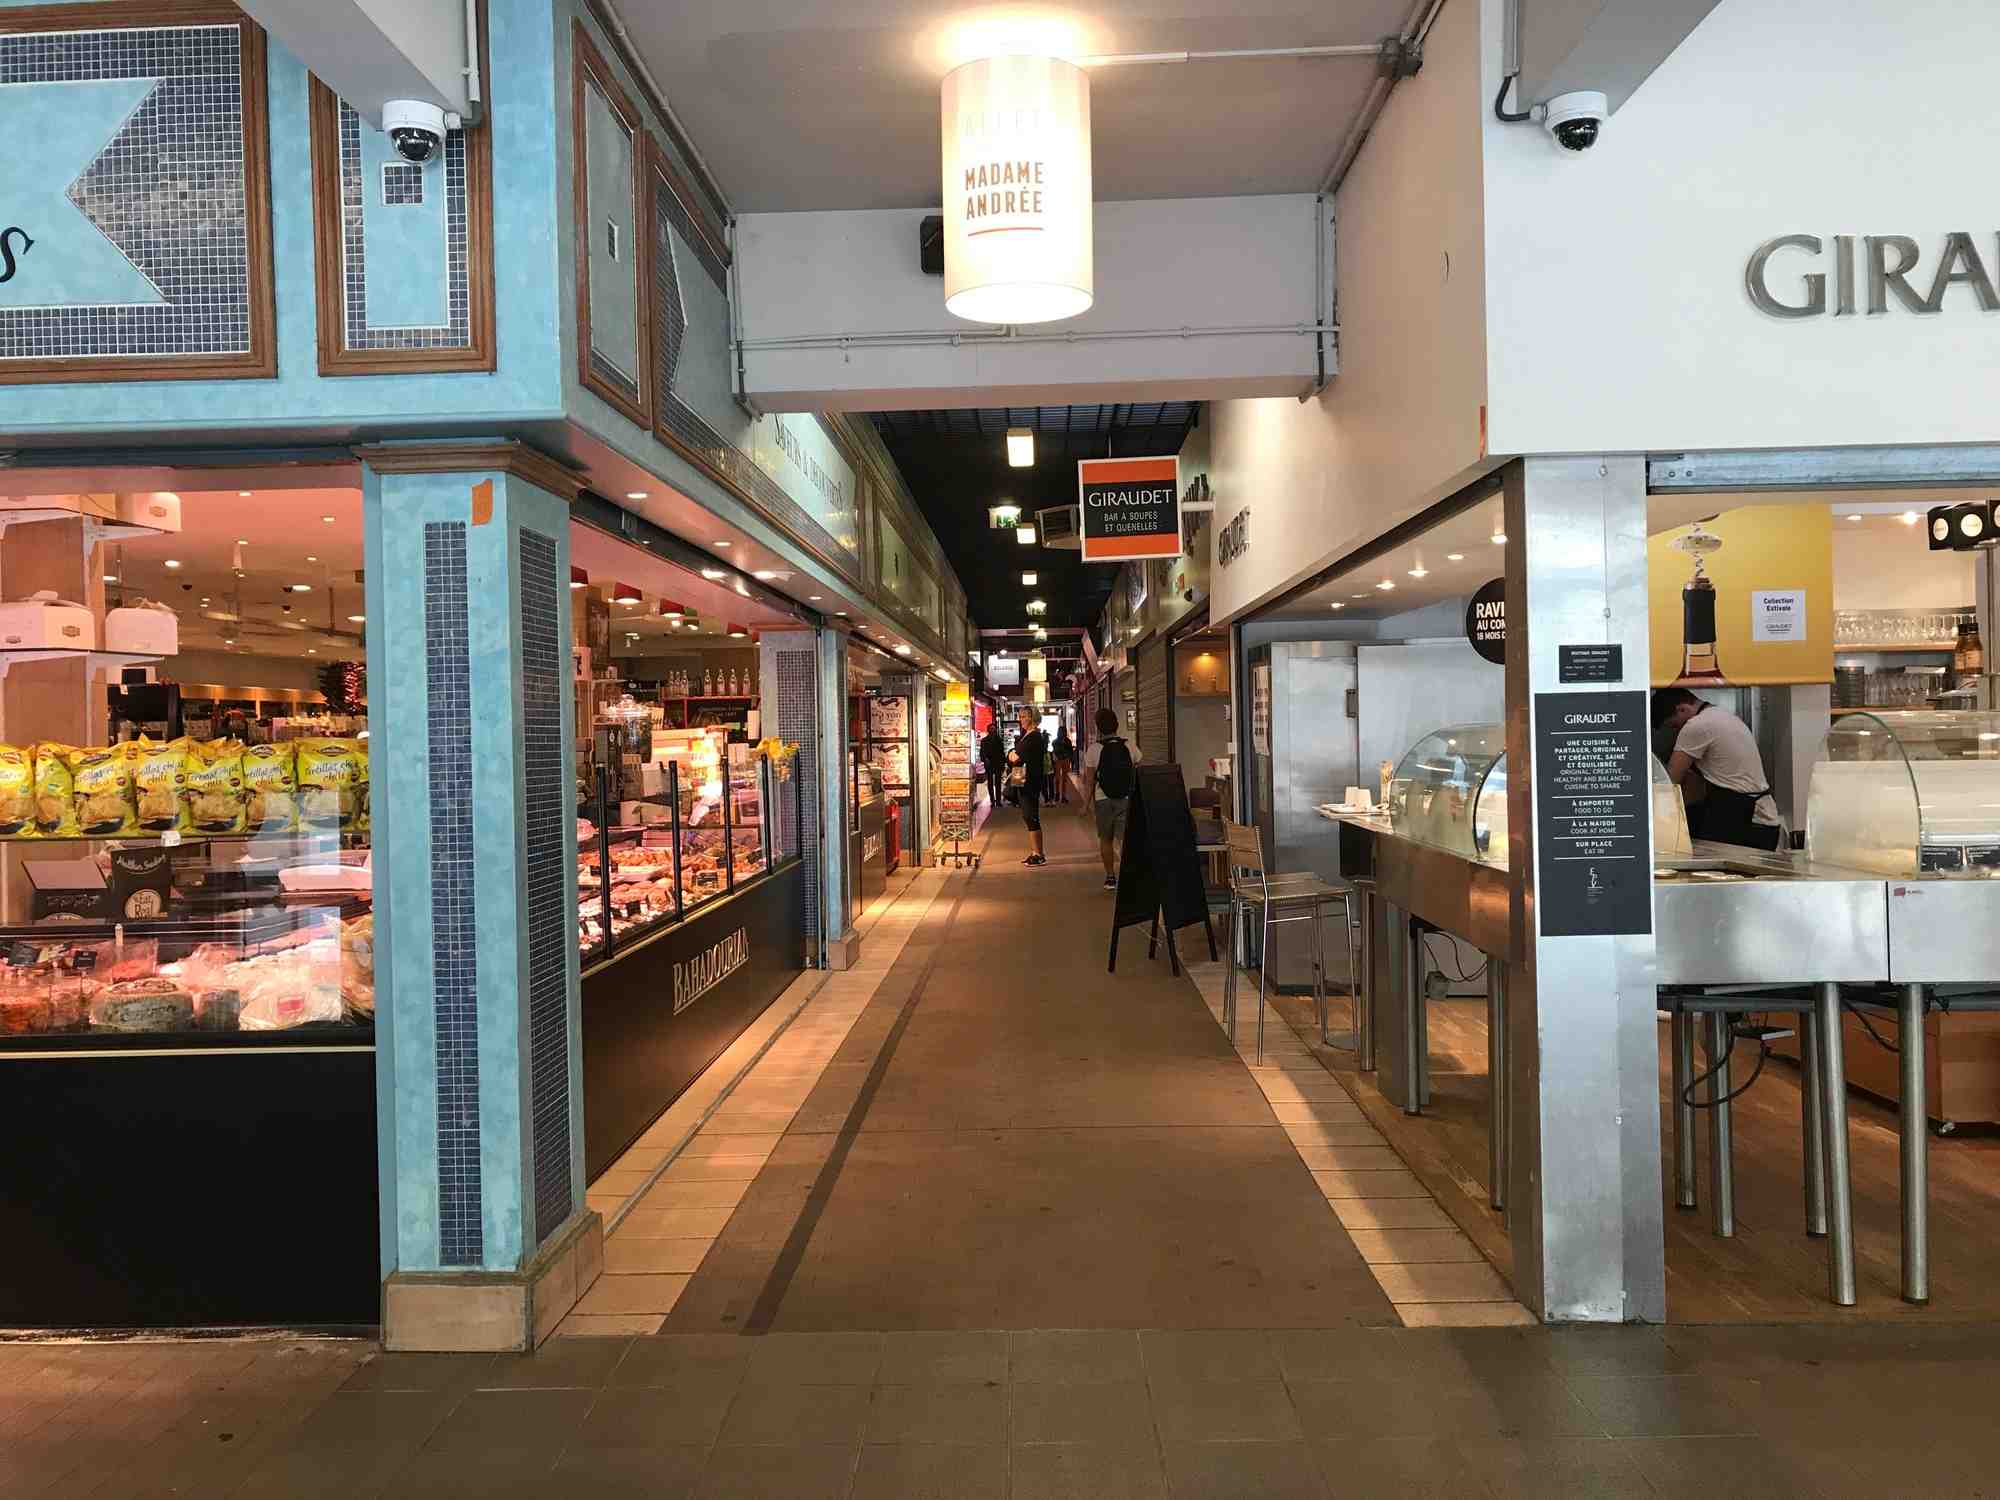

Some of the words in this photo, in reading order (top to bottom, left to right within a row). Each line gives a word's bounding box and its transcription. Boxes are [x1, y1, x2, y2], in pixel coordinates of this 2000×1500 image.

[964, 161, 1045, 191] MADAME
[966, 186, 1043, 220] ANDRÉE
[1745, 233, 2000, 318] GIRA
[1088, 489, 1173, 507] GIRAUDET
[1103, 512, 1119, 522] BAR
[1129, 510, 1158, 521] SOUPES
[1104, 523, 1114, 533] ET
[1116, 521, 1158, 533] QUENELLES
[1476, 619, 1488, 631] AU
[1485, 631, 1501, 640] MOIS
[1564, 713, 1617, 724] GIRAUDET
[672, 926, 749, 1012] BAHADOURIAN
